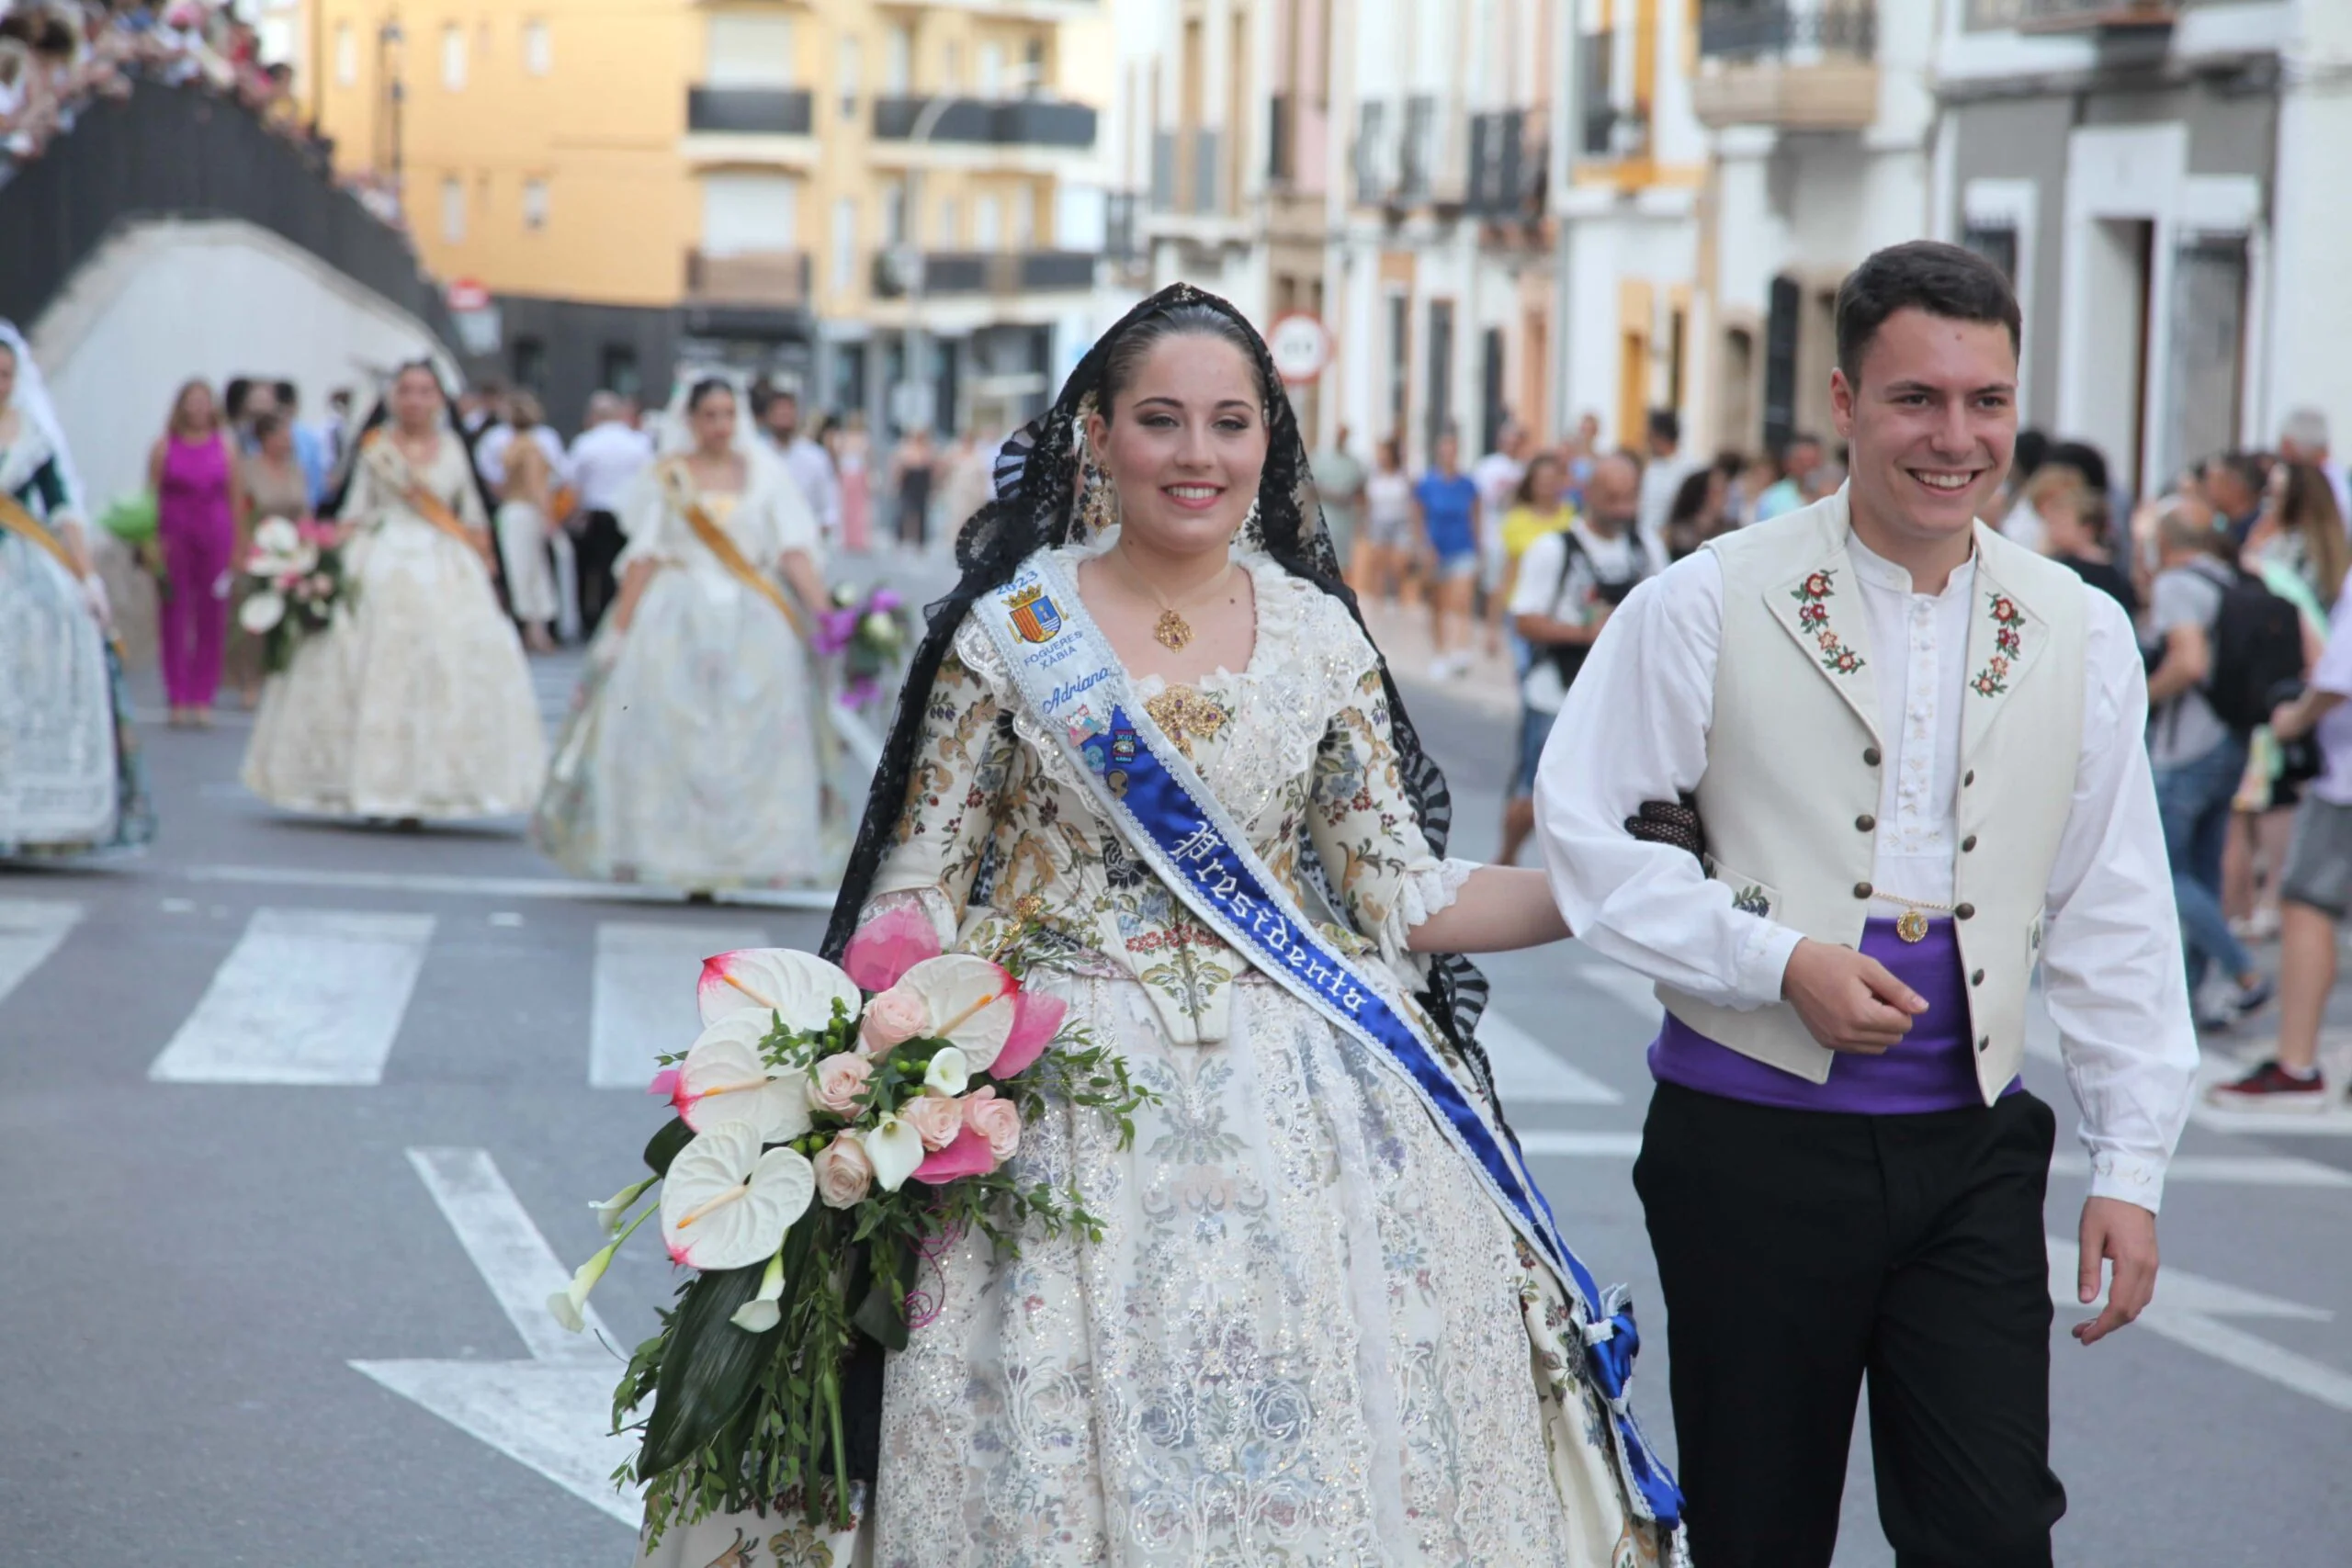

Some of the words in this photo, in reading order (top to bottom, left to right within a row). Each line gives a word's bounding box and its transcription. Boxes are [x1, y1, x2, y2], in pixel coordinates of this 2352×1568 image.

[996, 570, 1038, 595] 2023
[1023, 630, 1083, 667] FOGUERES
[1043, 668, 1108, 714] Adriana
[1170, 821, 1367, 1012] Presidenta
